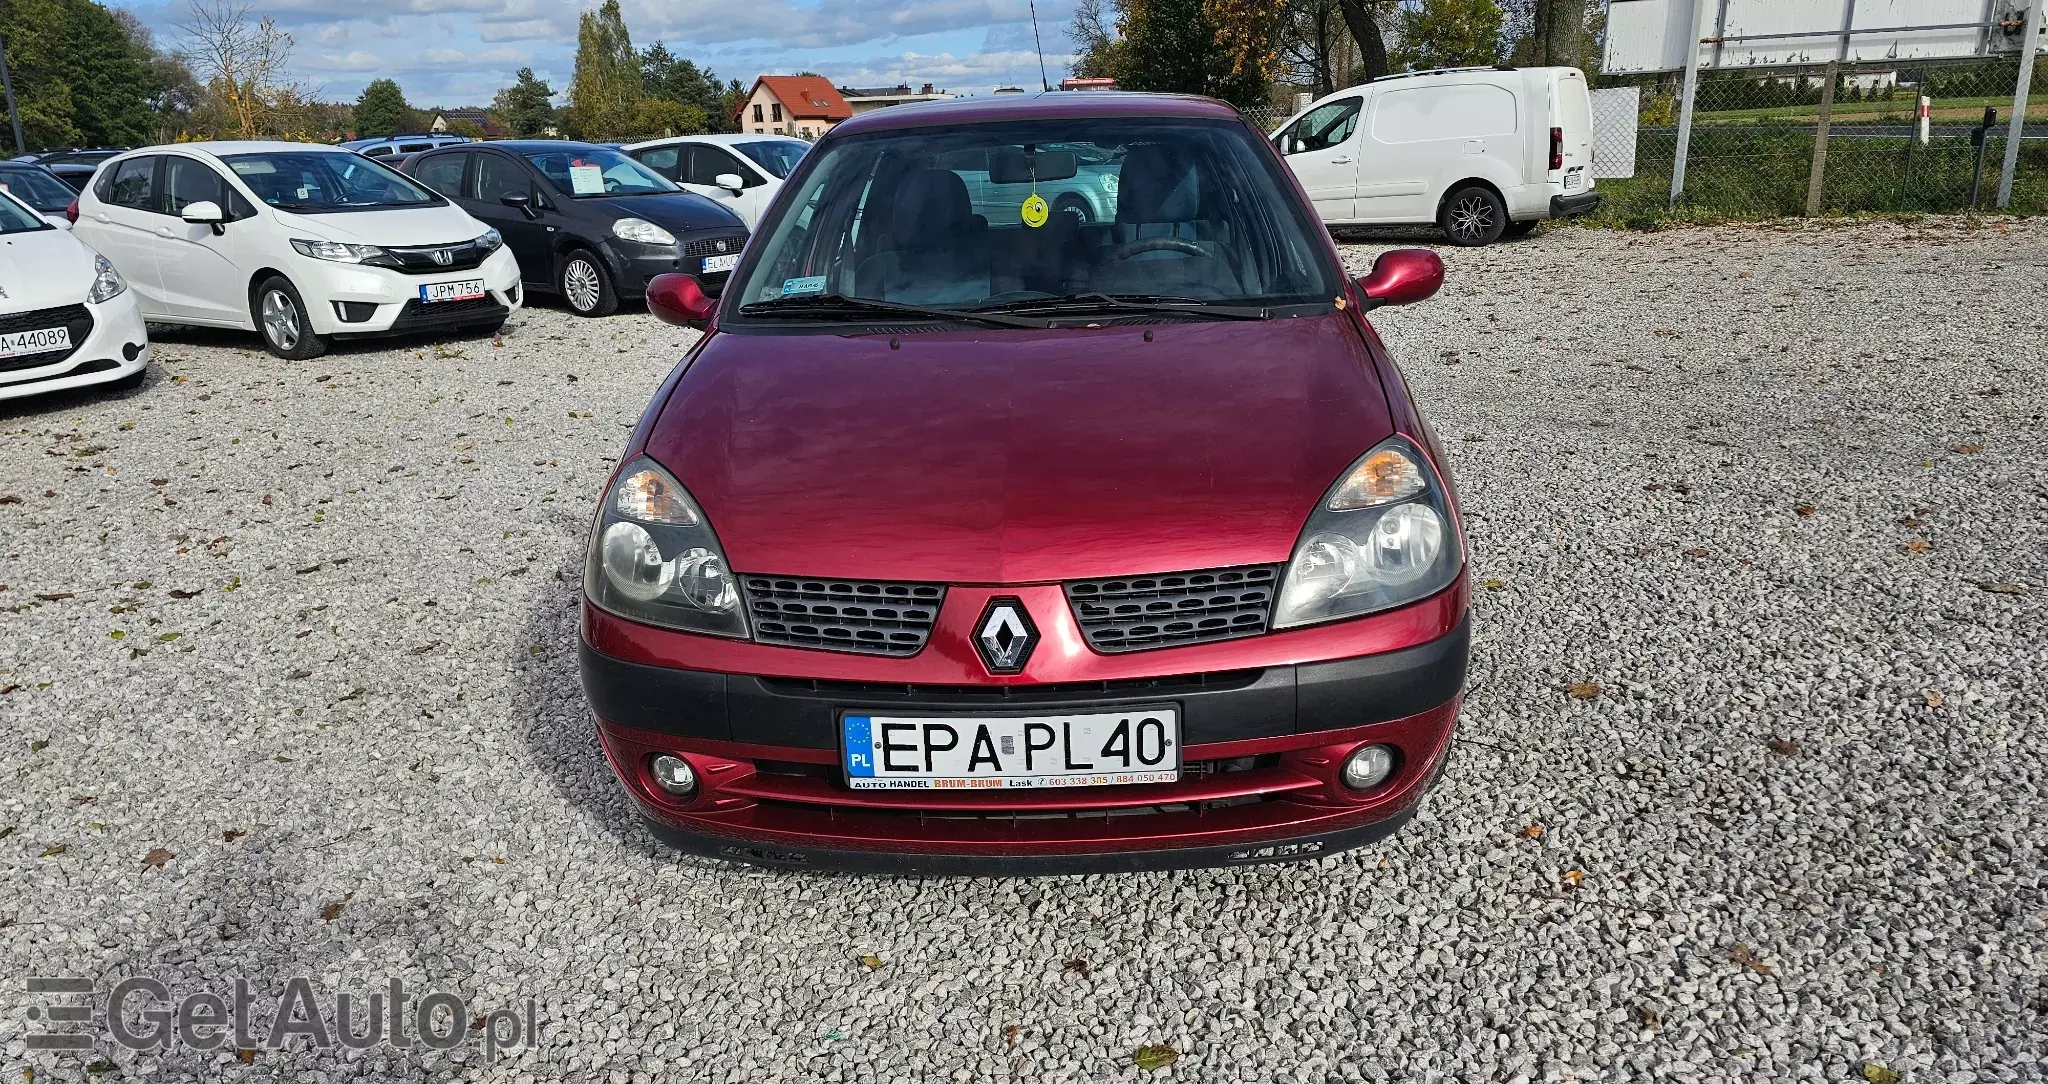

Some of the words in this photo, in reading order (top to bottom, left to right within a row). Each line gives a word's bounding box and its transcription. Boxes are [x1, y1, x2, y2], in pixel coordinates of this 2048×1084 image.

[433, 284, 455, 298] JPM
[457, 282, 480, 295] 756
[17, 329, 66, 349] 44089
[881, 723, 1003, 772] EPA
[1024, 717, 1166, 771] PL40
[851, 753, 871, 767] PL
[854, 781, 887, 789] AUTO
[889, 780, 930, 788] HANDEL
[934, 779, 1003, 788] BRUM-BRUM
[1116, 775, 1134, 783] 884
[1157, 773, 1176, 781] 470
